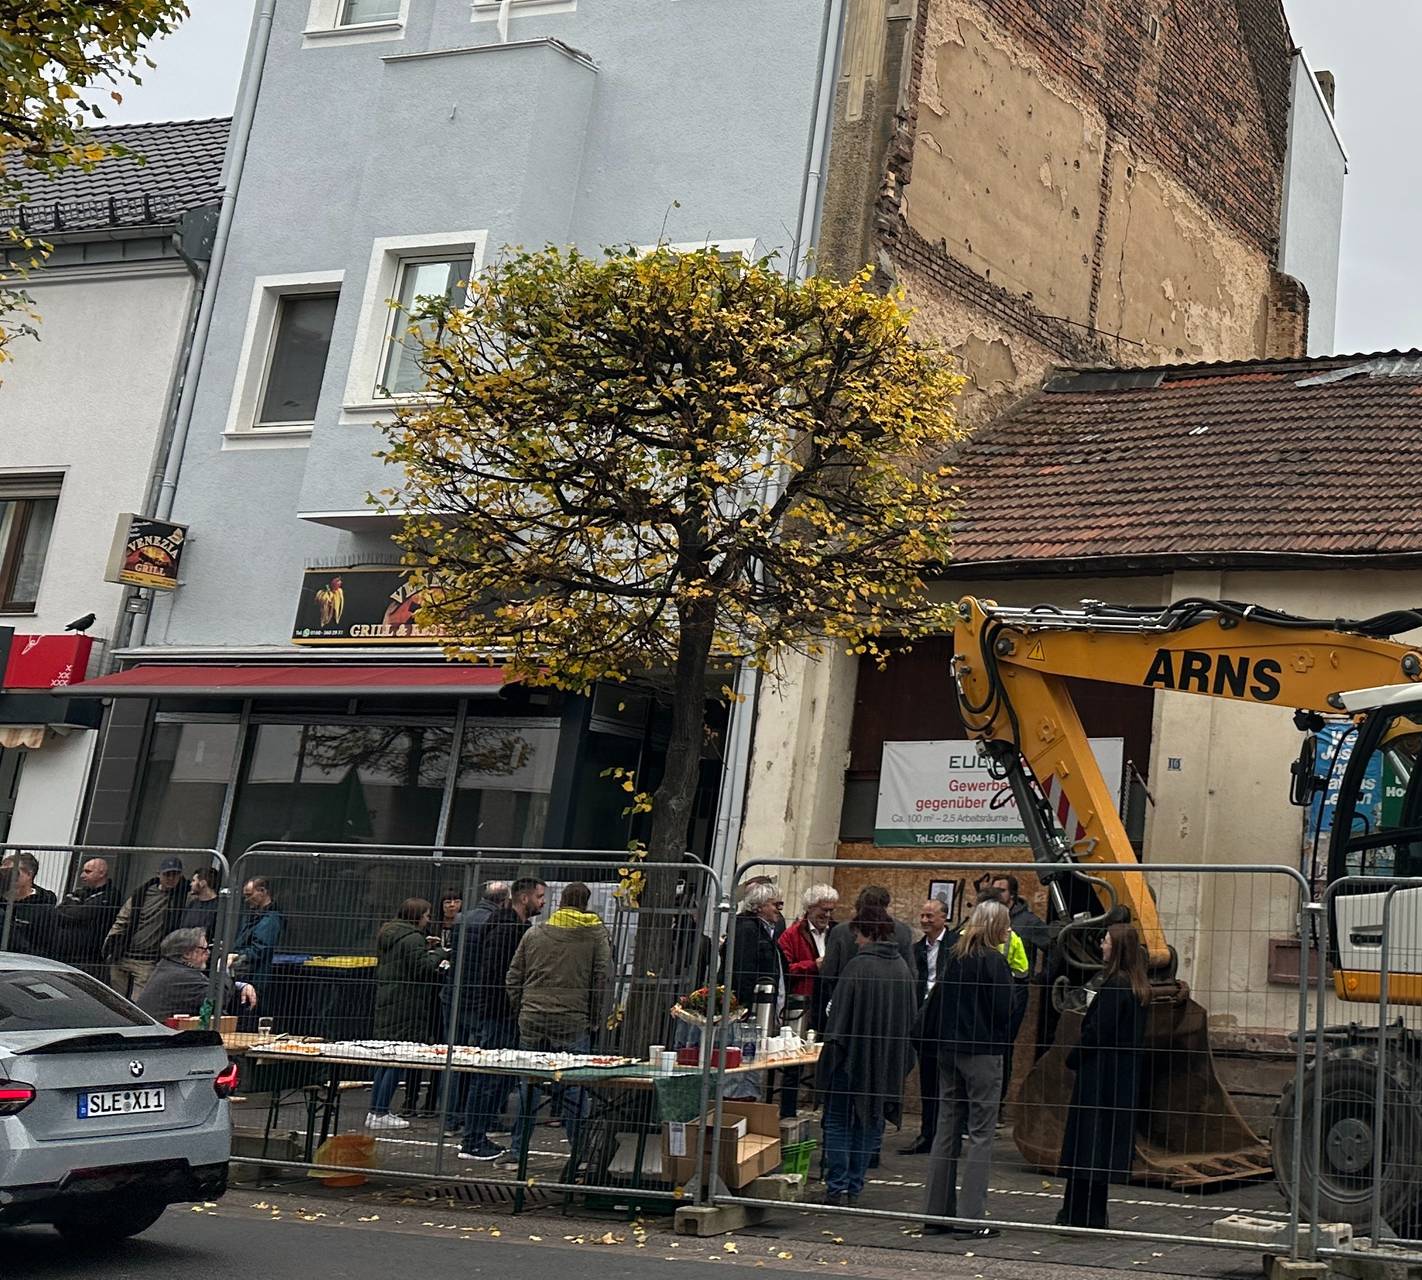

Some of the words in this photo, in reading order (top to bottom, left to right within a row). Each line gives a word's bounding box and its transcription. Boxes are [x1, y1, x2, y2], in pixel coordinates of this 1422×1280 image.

[128, 536, 178, 559] VENEZIA
[135, 563, 166, 576] GRILL
[350, 624, 393, 637] GRILL
[396, 624, 408, 637] &
[1143, 648, 1282, 701] ARNS
[949, 779, 1008, 792] Gewerbe
[916, 797, 986, 811] gegenüber
[891, 814, 904, 822] Ca.
[908, 814, 921, 822] 100
[957, 813, 1008, 822] Arbeitsräume
[935, 834, 958, 843] 02251
[962, 834, 995, 843] 9404-16
[90, 1094, 122, 1113] SLE
